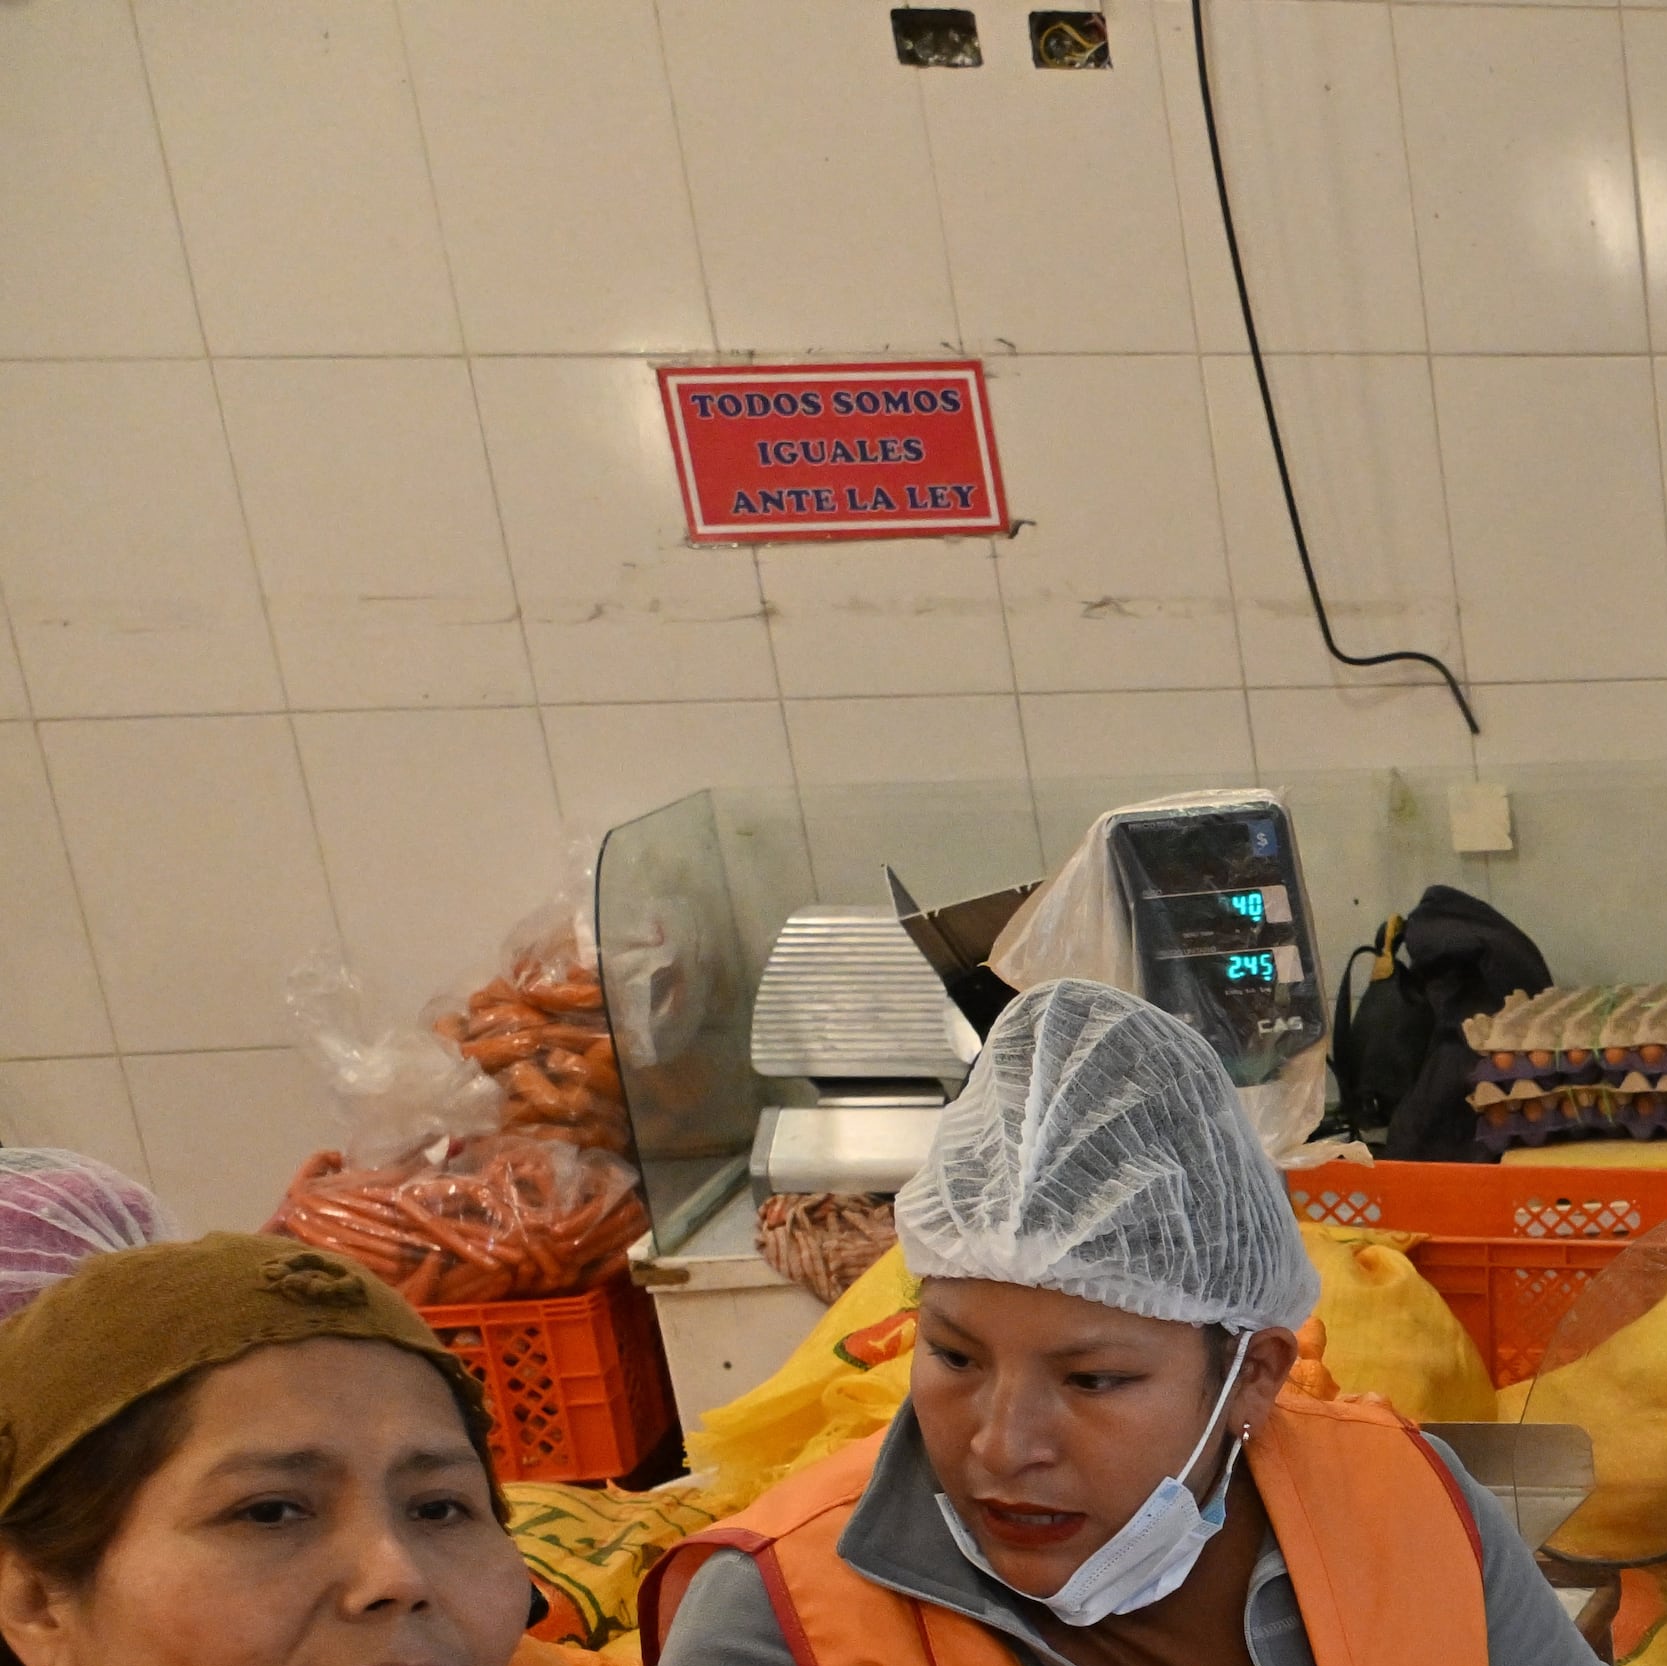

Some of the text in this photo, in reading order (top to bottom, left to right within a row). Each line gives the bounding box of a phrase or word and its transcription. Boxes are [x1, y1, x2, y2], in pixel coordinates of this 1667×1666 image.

[691, 390, 961, 418] TODOS SOMOS
[757, 439, 925, 466] IGUALES
[731, 485, 976, 514] ANTE LA LEY
